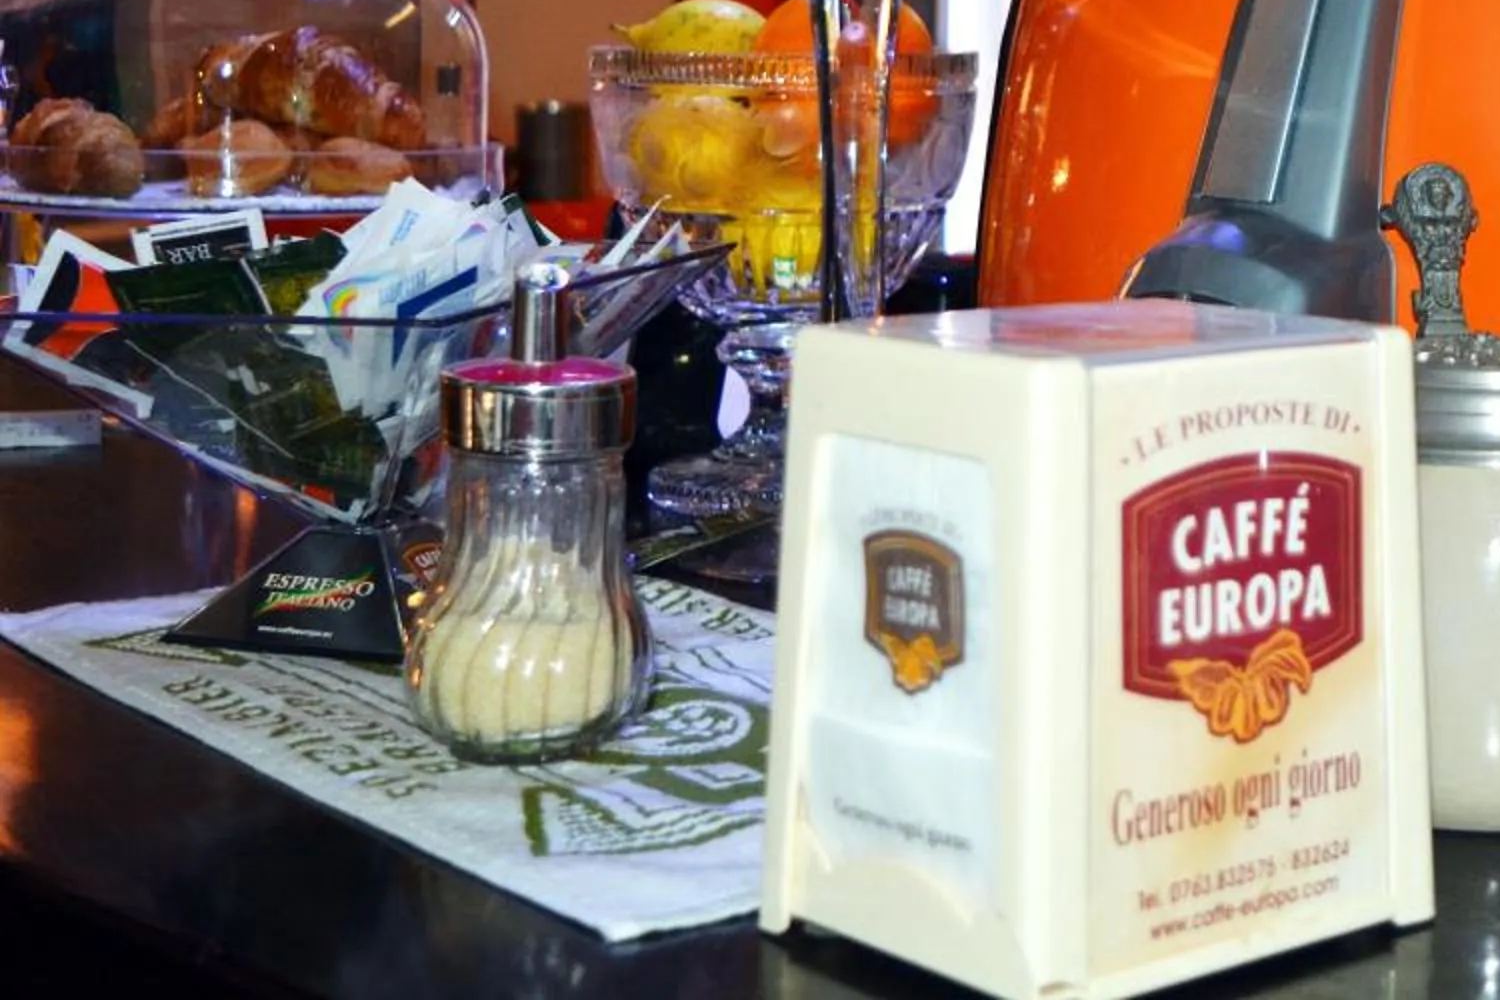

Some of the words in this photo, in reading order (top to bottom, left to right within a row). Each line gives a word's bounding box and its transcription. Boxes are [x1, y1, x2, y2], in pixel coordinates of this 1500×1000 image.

[1132, 424, 1172, 462] LE
[1178, 399, 1318, 442] PROPOSTE
[1323, 406, 1352, 434] DI
[263, 572, 376, 598] ESPRESSO
[265, 590, 356, 613] ITALIANO
[1157, 563, 1333, 648] EUROPA
[1111, 787, 1227, 848] Generoso
[1232, 753, 1282, 830] ogni
[1288, 747, 1363, 820] giorno
